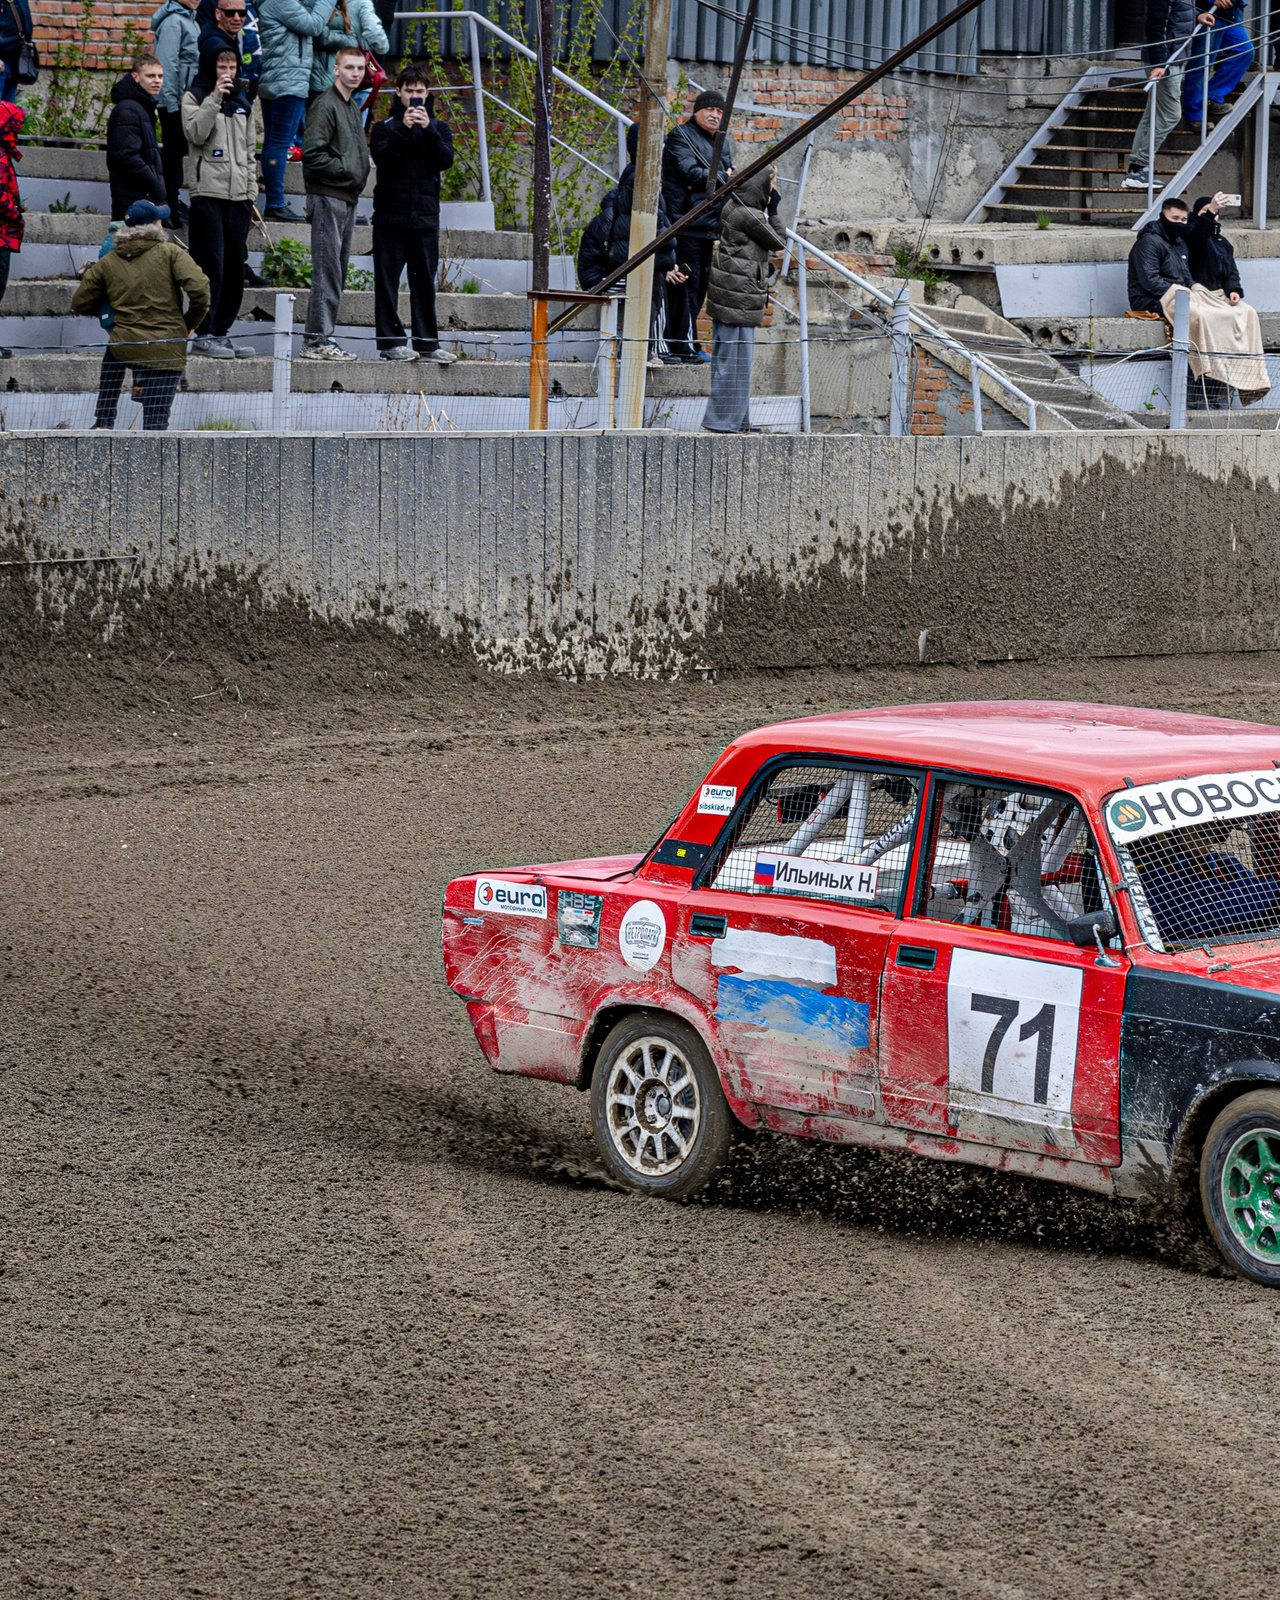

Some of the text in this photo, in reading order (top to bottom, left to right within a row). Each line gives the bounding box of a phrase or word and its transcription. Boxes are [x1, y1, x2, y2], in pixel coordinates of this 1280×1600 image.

[710, 788, 734, 797] eurol
[699, 802, 732, 812] sibsklad.ru
[776, 860, 874, 894] Ильиных Н.
[495, 888, 546, 908] eurol
[970, 992, 1056, 1105] 71
